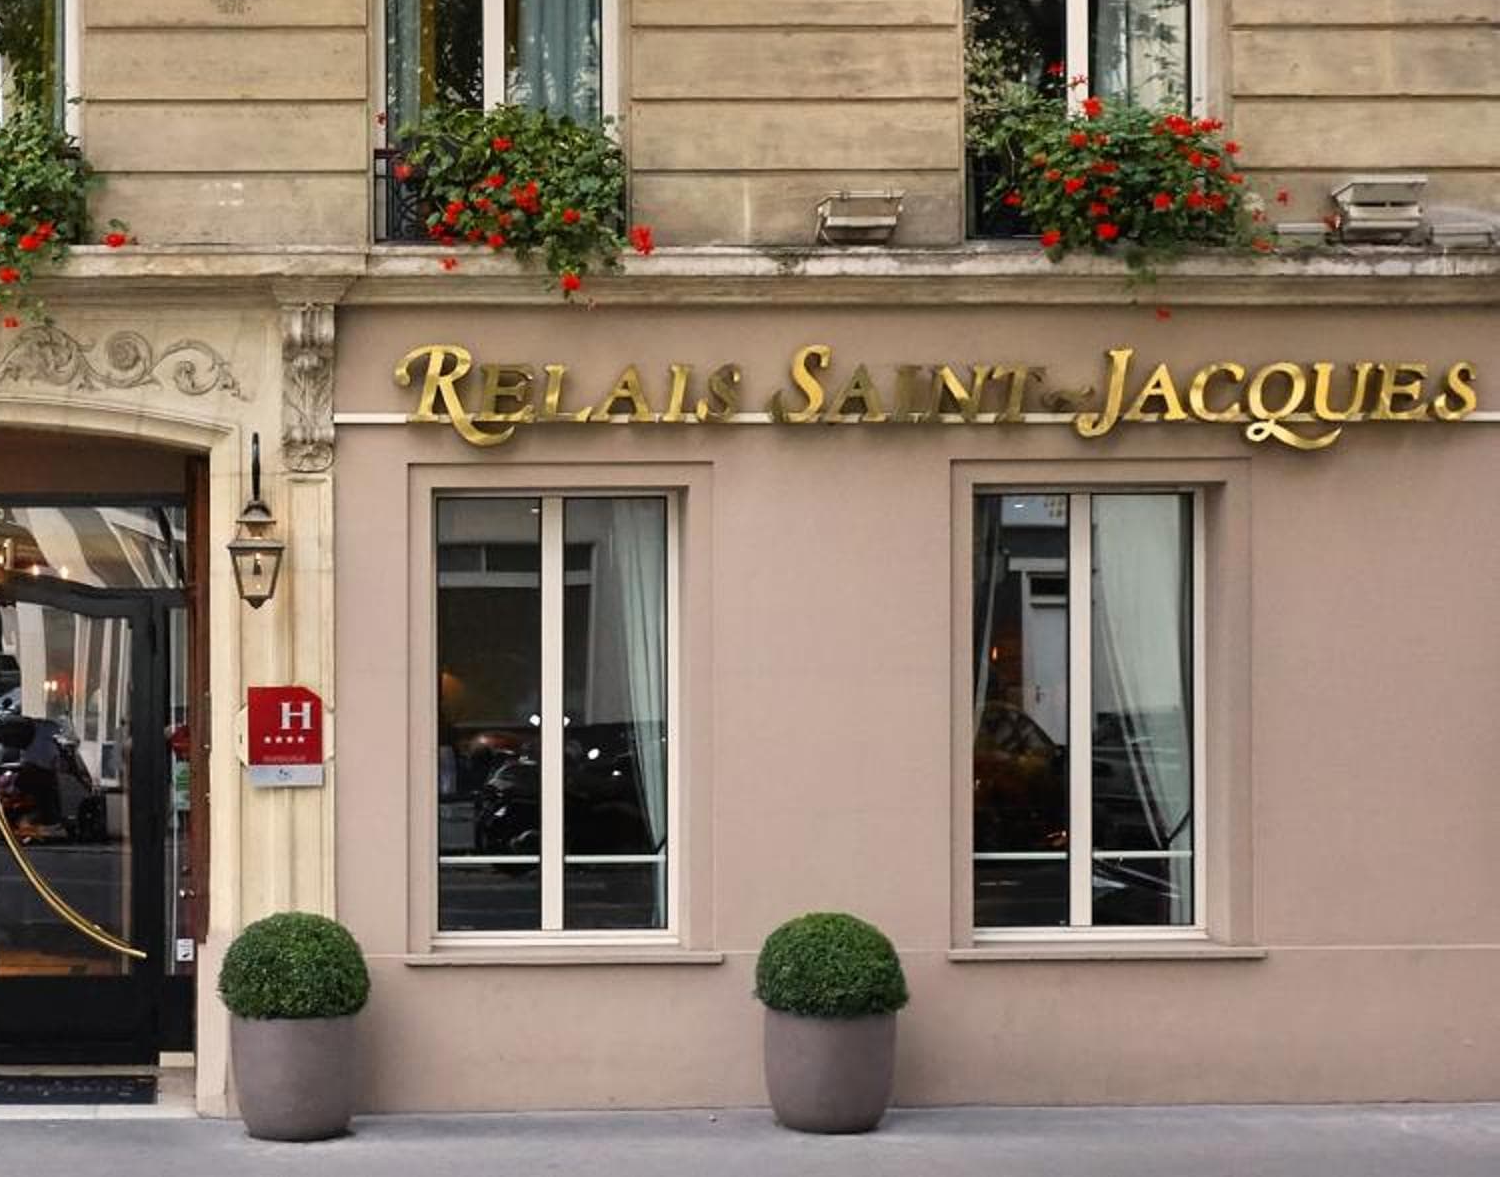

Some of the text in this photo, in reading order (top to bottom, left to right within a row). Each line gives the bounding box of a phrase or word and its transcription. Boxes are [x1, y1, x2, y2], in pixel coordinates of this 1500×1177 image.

[394, 343, 1479, 450] RELAIS SAINT JACQUES
[280, 701, 312, 730] H
